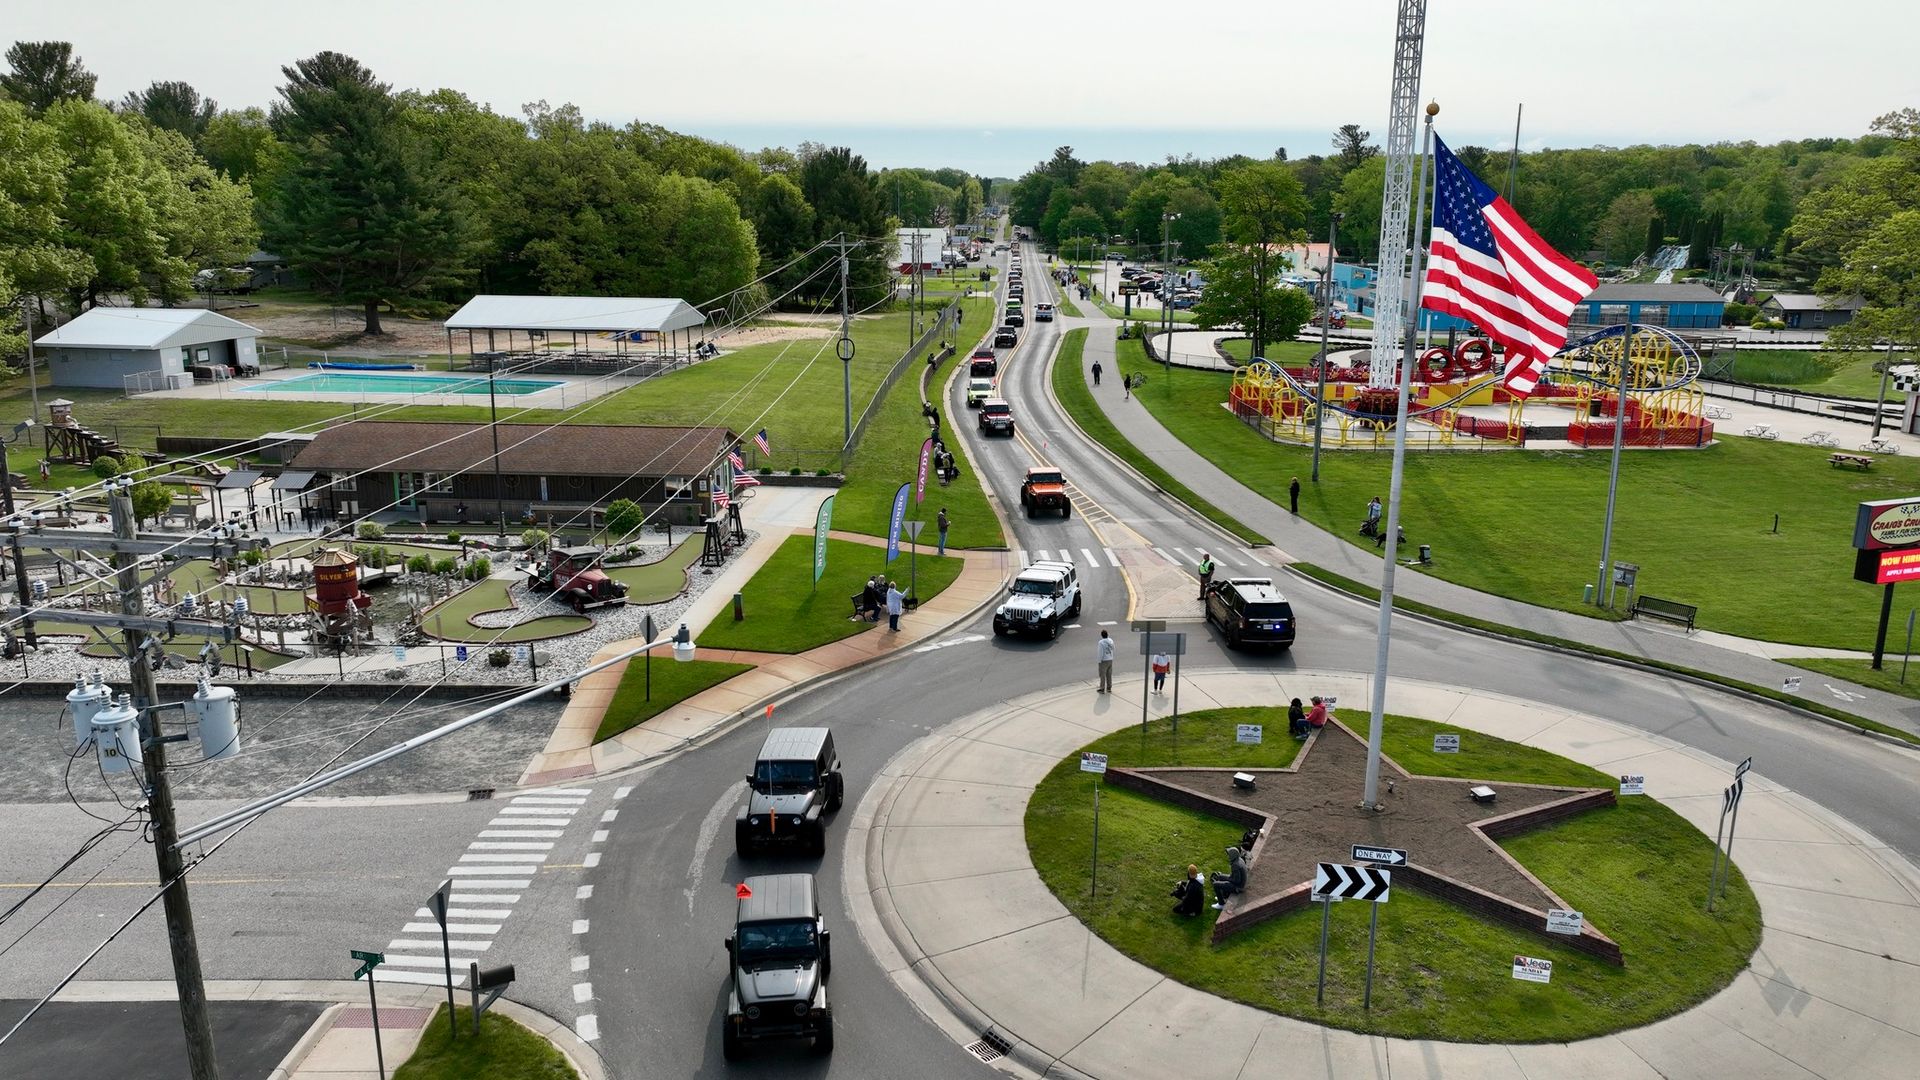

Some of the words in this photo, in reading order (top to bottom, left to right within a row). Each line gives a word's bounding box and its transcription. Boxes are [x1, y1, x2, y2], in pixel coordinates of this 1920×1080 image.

[918, 450, 929, 493] CANDY
[894, 495, 904, 528] MINING
[819, 510, 829, 538] GOLF
[1873, 520, 1903, 531] CRAIG'S
[1882, 557, 1902, 566] NOW
[320, 573, 342, 581] SILVER
[105, 749, 116, 757] 10
[1357, 850, 1374, 858] ONE
[1376, 852, 1392, 860] WAY
[1528, 959, 1551, 970] Jeep
